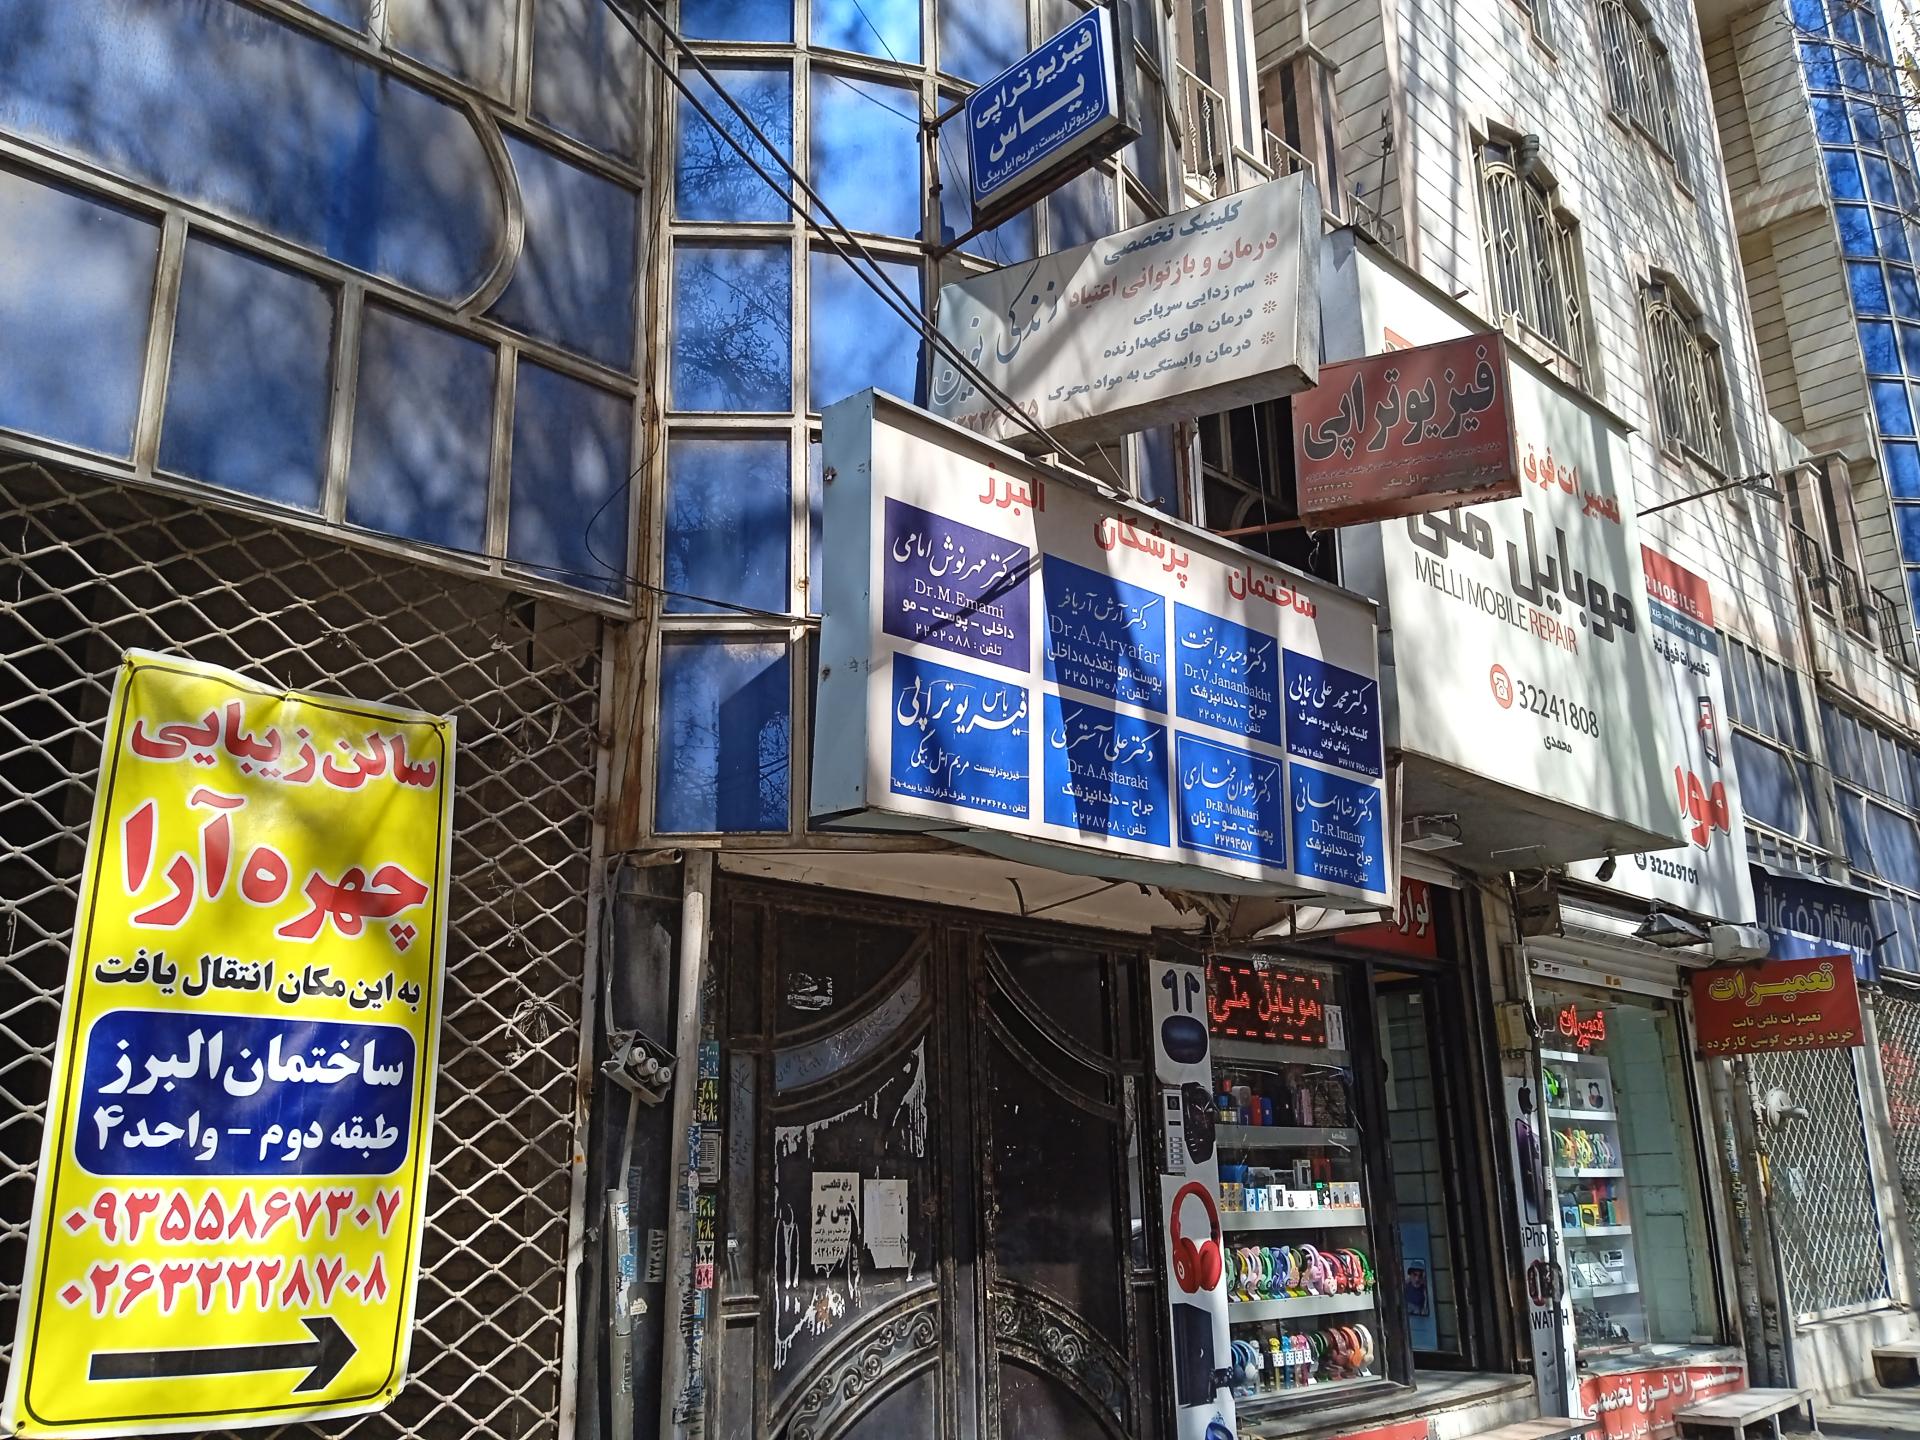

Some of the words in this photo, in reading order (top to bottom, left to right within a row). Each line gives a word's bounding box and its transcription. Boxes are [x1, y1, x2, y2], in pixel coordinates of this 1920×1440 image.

[976, 27, 1092, 129] فیزیوتراپی
[989, 73, 1085, 162] یاس
[1014, 145, 1035, 167] مریم
[981, 168, 1002, 189] بیگی
[1179, 200, 1243, 237] کلینیک
[1103, 222, 1175, 266] تخصصی
[1217, 231, 1279, 271] درمان
[1121, 253, 1196, 300] بازتوانی
[1200, 256, 1212, 277] و
[1068, 276, 1118, 311] اعتیاد
[1185, 285, 1230, 310] زدایی
[1232, 279, 1256, 297] سم
[1133, 301, 1183, 326] سرپایی
[1207, 307, 1254, 332] درمان
[1174, 321, 1204, 343] های
[1205, 337, 1252, 363] درمان
[1093, 374, 1123, 391] مواد
[1126, 369, 1140, 383] به
[1047, 384, 1091, 402] محرک
[1303, 345, 1496, 461] فیزیوتراپی
[1523, 443, 1555, 491] فوق
[978, 461, 1047, 518] البرز
[1557, 465, 1621, 526] تعمیرات
[892, 532, 933, 563] امامی
[927, 535, 988, 582] مهرنوش
[1093, 513, 1191, 590] پزشکان
[978, 547, 1023, 589] دکتر
[1506, 508, 1637, 644] موبایل
[902, 599, 917, 613] مو
[914, 578, 1006, 620] Dr.M.Emami
[1057, 587, 1099, 615] آریافر
[1227, 566, 1318, 621] ساختمان
[1414, 551, 1466, 603] MELLI
[1467, 580, 1528, 632] MOBILE
[1529, 609, 1580, 656] REPAIR
[1653, 580, 1697, 615] MOBILE
[931, 606, 969, 633] پوست
[1094, 597, 1129, 623] آرش
[1121, 598, 1159, 631] دکتر
[915, 622, 971, 650] ۲۲۰۲۰۸۸
[981, 621, 1015, 641] داخلی
[1050, 614, 1161, 665] Dr.A.Aryafar
[1226, 651, 1249, 675] وحید
[1242, 640, 1273, 676] دکتر
[1663, 640, 1680, 665] فوق
[1679, 650, 1711, 678] تعمیرات
[1064, 668, 1120, 695] ۲۲۵۱۳۰۸
[1183, 662, 1273, 703] Dr.V.Jananbakht
[1190, 685, 1239, 708] دندانپزشک
[1312, 680, 1333, 708] علی
[1247, 704, 1268, 721] جراح
[1332, 690, 1350, 709] محمد
[1344, 681, 1373, 715] دکتر
[1516, 679, 1600, 740] 32241808
[1198, 707, 1239, 729] ۲۲۰۲۰۸۸
[131, 702, 315, 782] زیبایی
[1104, 733, 1129, 762] علی
[1121, 728, 1161, 764] دکتر
[1543, 738, 1574, 755] محمدی
[323, 733, 437, 789] سالن
[973, 763, 1020, 781] فیزیوتراپیست
[1066, 758, 1149, 790] Dr.A.Astaraki
[1183, 759, 1237, 791] مختاری
[1061, 782, 1120, 806] دندانپزشک
[1226, 773, 1257, 801] رضوان
[1252, 767, 1276, 806] دکتر
[1295, 777, 1341, 821] ایمانی
[1071, 811, 1120, 833] ۲۲۲۸۷۰۸
[1131, 799, 1155, 817] جراح
[1190, 810, 1211, 829] زنان
[1205, 798, 1260, 821] Dr.R.Mokhtari
[1341, 797, 1357, 818] رضا
[1353, 790, 1378, 826] دکتر
[1221, 819, 1238, 833] مو
[1247, 823, 1274, 845] پوست
[1311, 819, 1366, 848] Dr.R.Imany
[125, 788, 245, 927] آرا
[1305, 837, 1348, 858] دندانپزشک
[1356, 850, 1374, 867] جراح
[1650, 854, 1700, 886] 32229701
[241, 846, 429, 951] چهره
[95, 949, 177, 996] یافت
[183, 956, 273, 997] انتقال
[277, 966, 345, 1003] مکان
[1709, 963, 1836, 1008] تعمیرات
[349, 972, 395, 1009] این
[398, 977, 421, 1013] به
[1208, 975, 1251, 1022] ملی
[1259, 980, 1319, 1027] موبایل
[1818, 1033, 1825, 1044] و
[1826, 1027, 1855, 1041] خرید
[98, 1030, 224, 1095] البرز
[223, 1034, 404, 1097] ساختمان
[259, 1123, 324, 1161] دوم
[330, 1114, 399, 1159] طبقه
[65, 1190, 400, 1243] ۰۹۳۵۵۸۶۷۳۰۷
[1521, 1226, 1560, 1248] iPhoe
[61, 1255, 388, 1314] ۰۲۶۳۲۲۲۸۷۰۸
[1531, 1308, 1570, 1330] WATH
[1581, 1376, 1634, 1420] تخصصی
[1636, 1374, 1670, 1413] فوق
